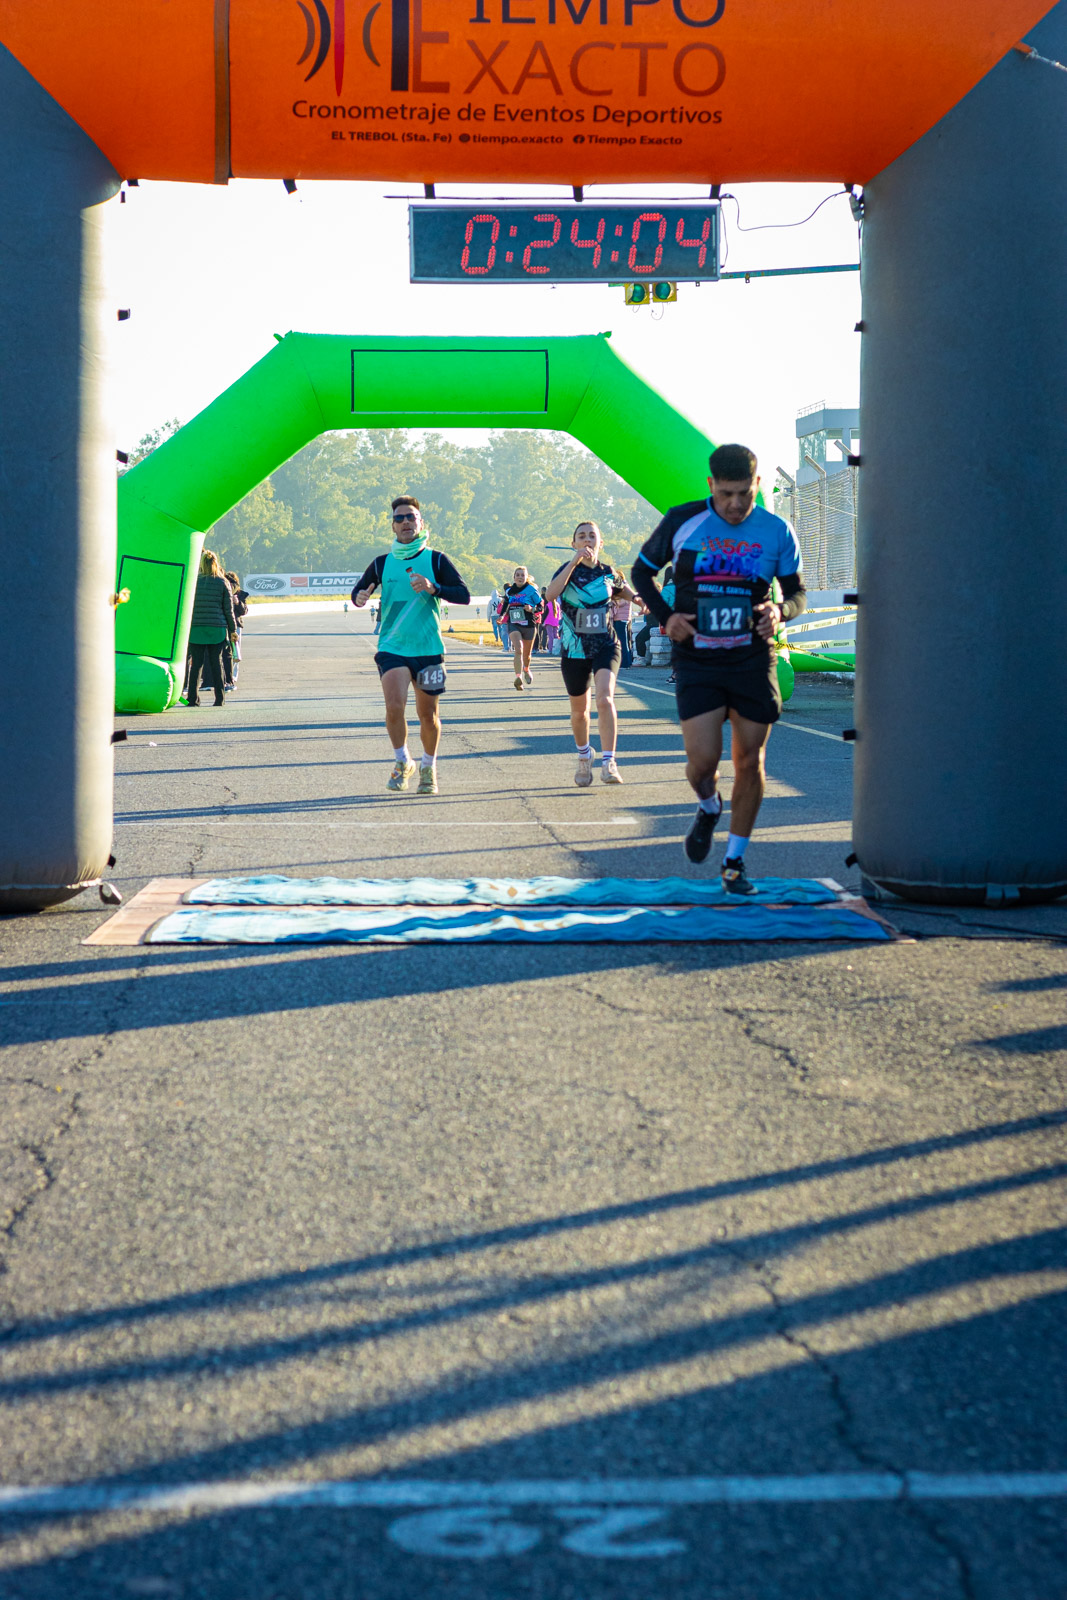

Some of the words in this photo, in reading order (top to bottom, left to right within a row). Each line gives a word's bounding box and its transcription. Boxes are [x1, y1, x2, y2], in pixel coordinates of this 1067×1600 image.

[292, 100, 450, 125] Cronometraje
[457, 103, 486, 121] de
[493, 103, 585, 122] Eventos
[592, 105, 723, 127] Deportivos
[331, 131, 346, 140] EL
[349, 131, 399, 142] TREBOL
[401, 132, 430, 143] (Sta.
[433, 133, 453, 143] Fe)
[472, 134, 563, 145] tiempo.exacto
[587, 135, 637, 146] Tiempo
[639, 135, 683, 146] Exacto
[461, 213, 711, 275] 0:24:04
[254, 580, 278, 590] Ford
[586, 613, 600, 628] 13
[709, 608, 742, 631] 127
[423, 669, 444, 685] 145
